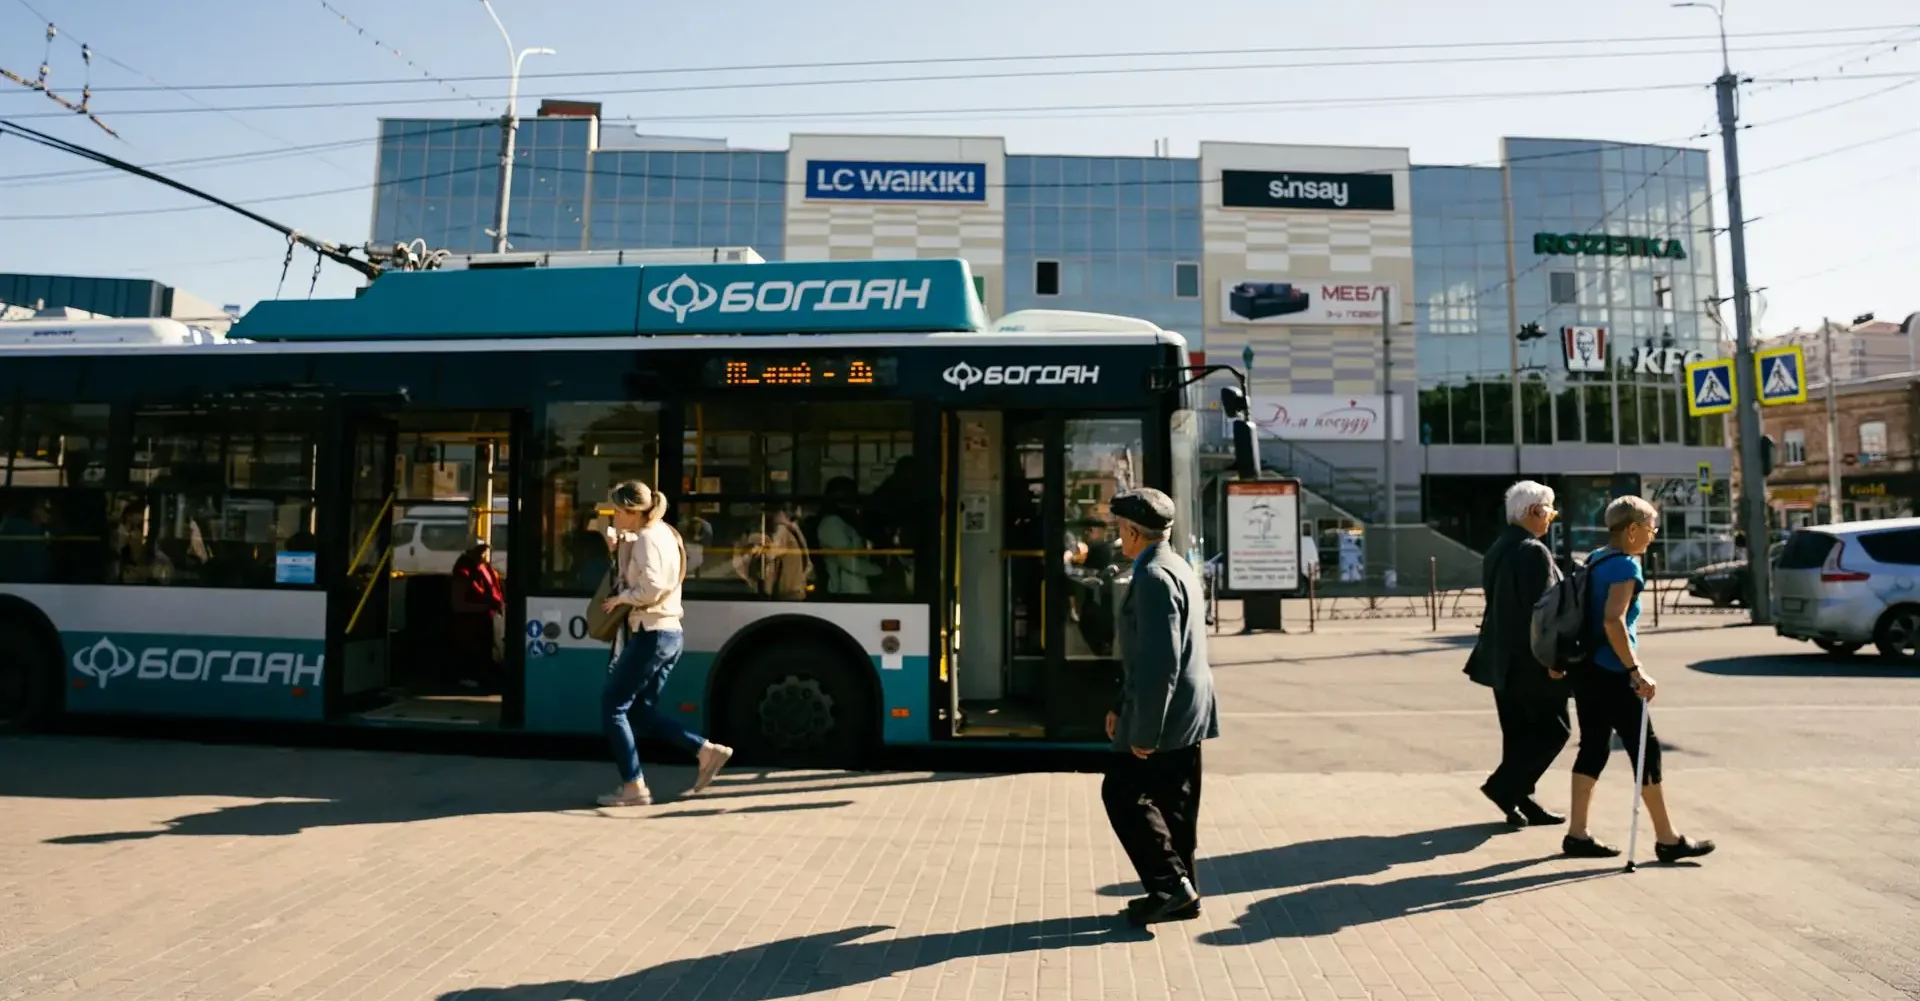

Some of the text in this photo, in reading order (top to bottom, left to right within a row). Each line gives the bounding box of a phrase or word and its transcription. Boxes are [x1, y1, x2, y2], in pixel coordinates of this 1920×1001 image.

[816, 168, 855, 192] LC
[1268, 174, 1349, 207] sinsay
[1533, 232, 1687, 260] ROZETKA
[719, 278, 931, 313] БОГДАН
[983, 364, 1100, 385] БОГДАН
[137, 647, 325, 687] БОГДАН
